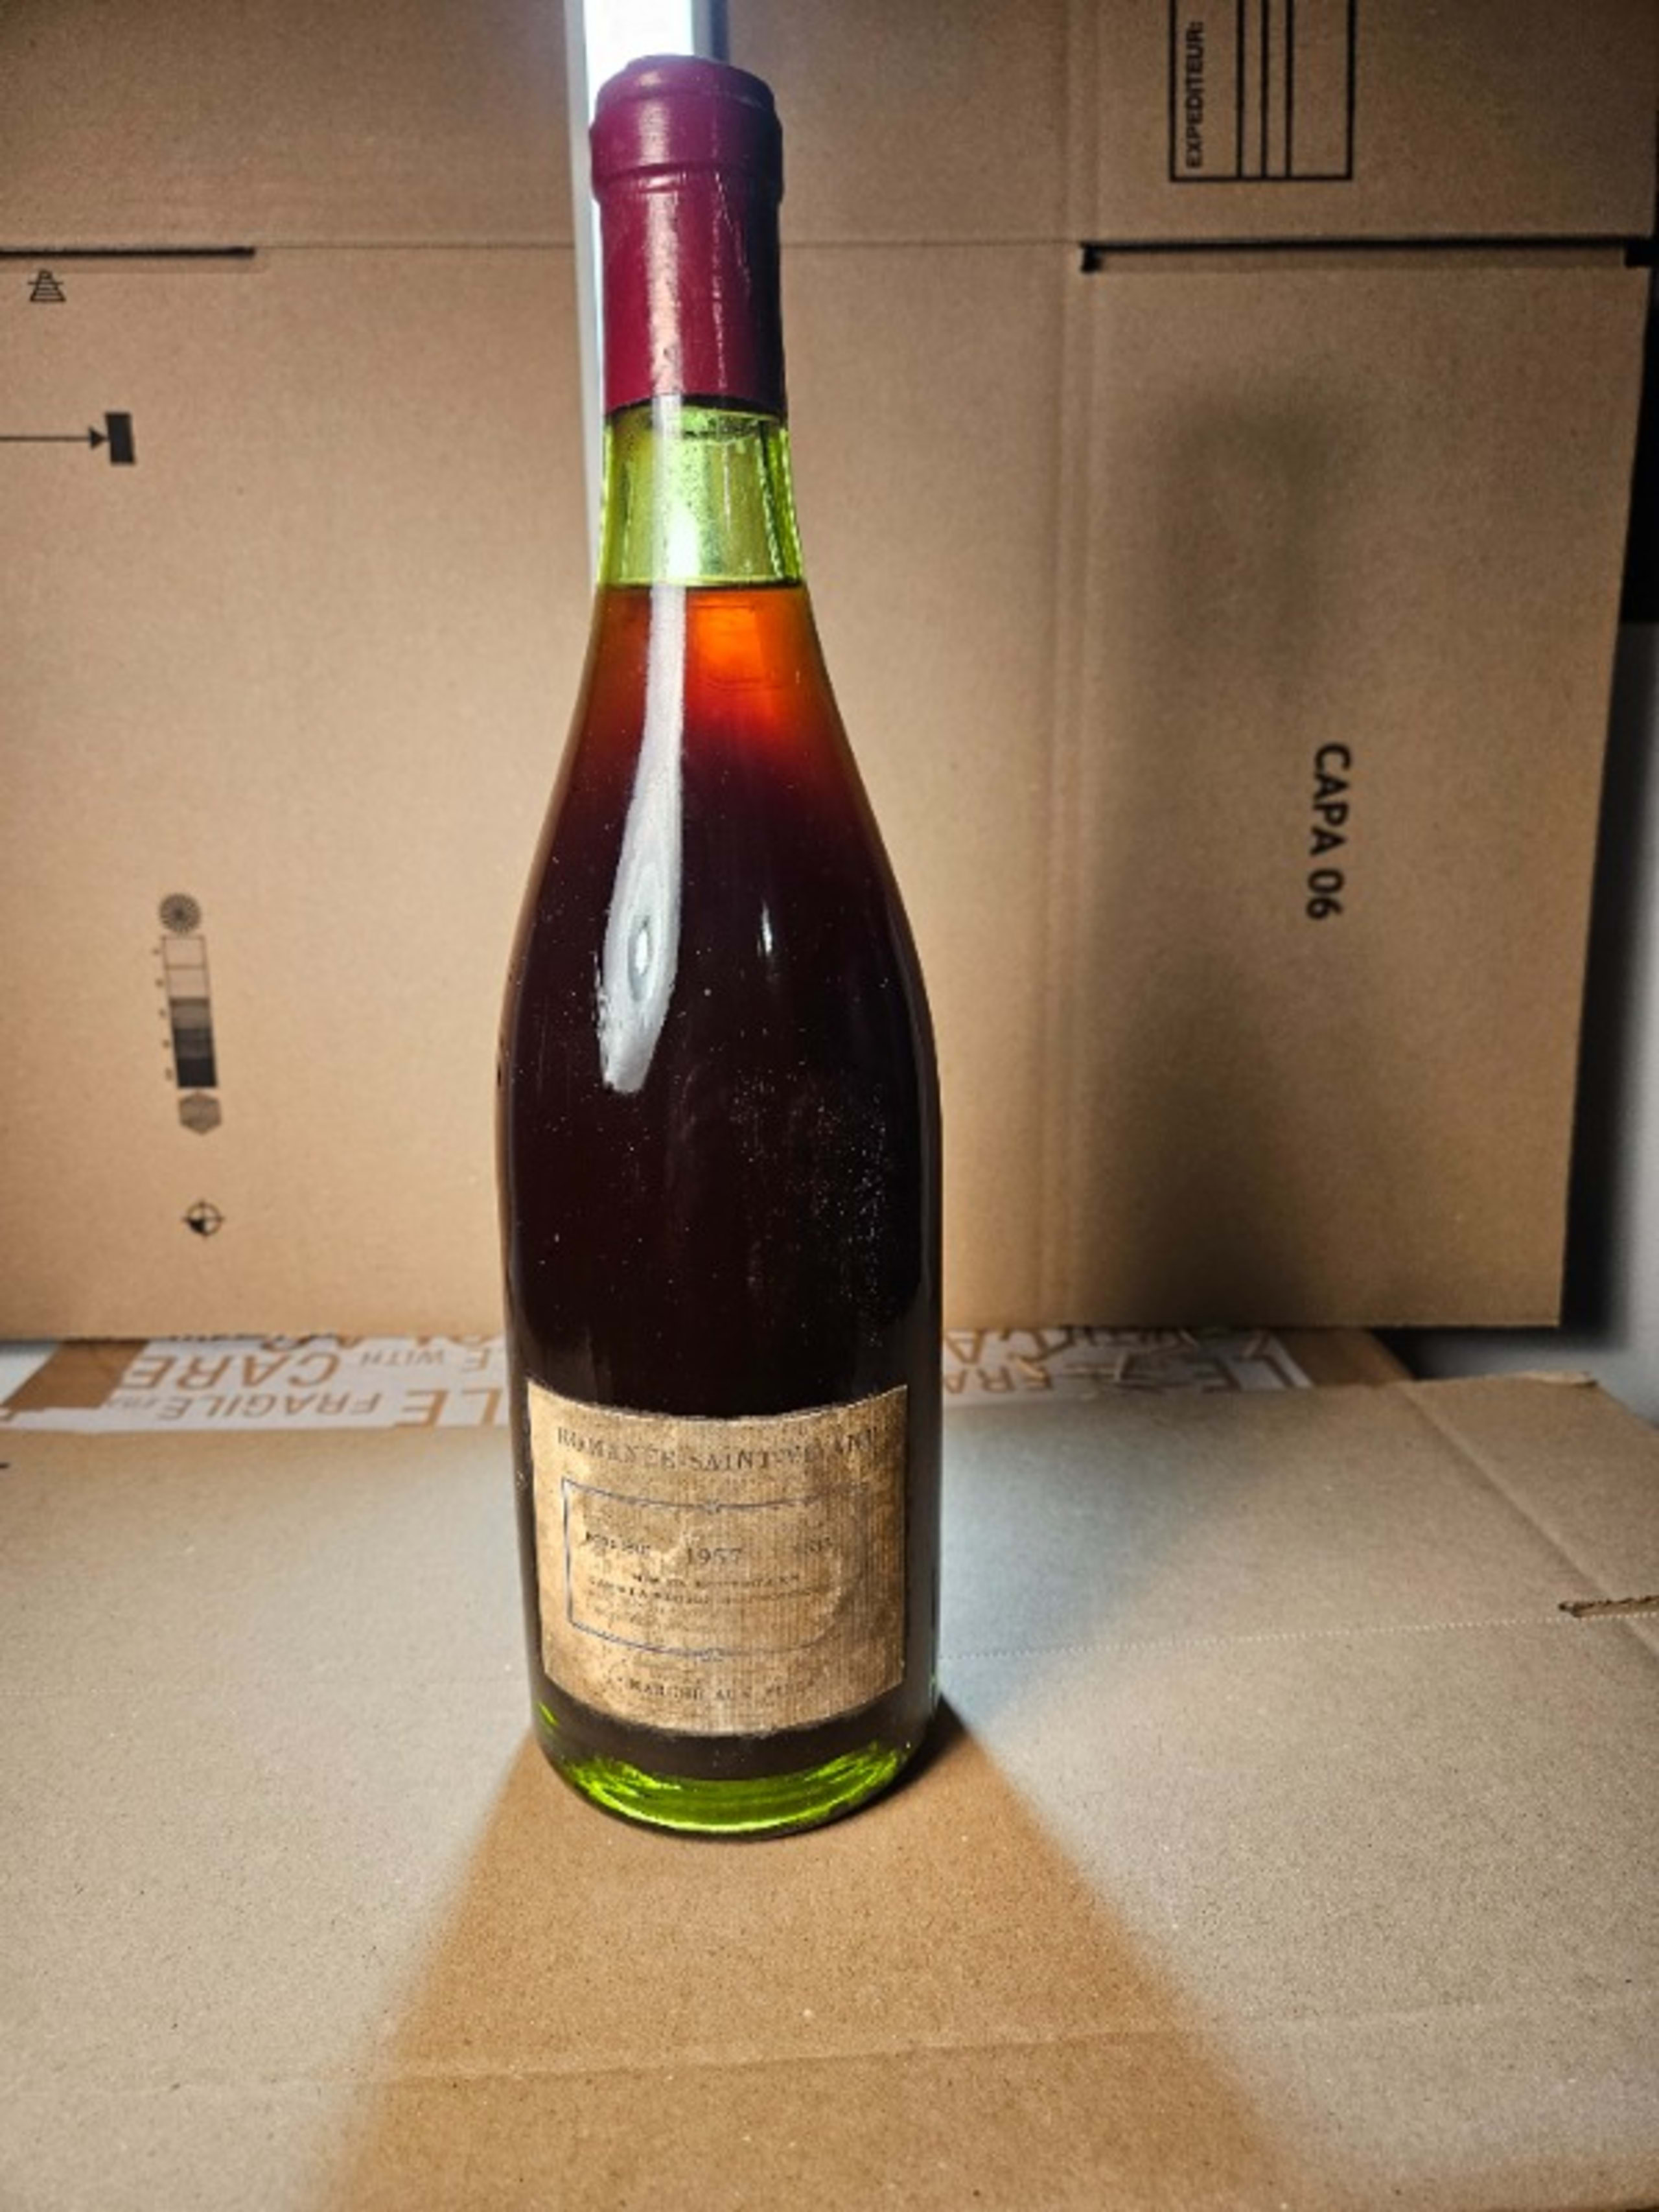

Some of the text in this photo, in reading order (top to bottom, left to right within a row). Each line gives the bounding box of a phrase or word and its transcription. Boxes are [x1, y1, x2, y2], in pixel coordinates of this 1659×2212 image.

[1305, 743, 1352, 920] CAPA 06
[124, 1351, 342, 1388] CARE
[360, 1349, 445, 1368] WITH
[156, 1390, 383, 1421] FRAGILE
